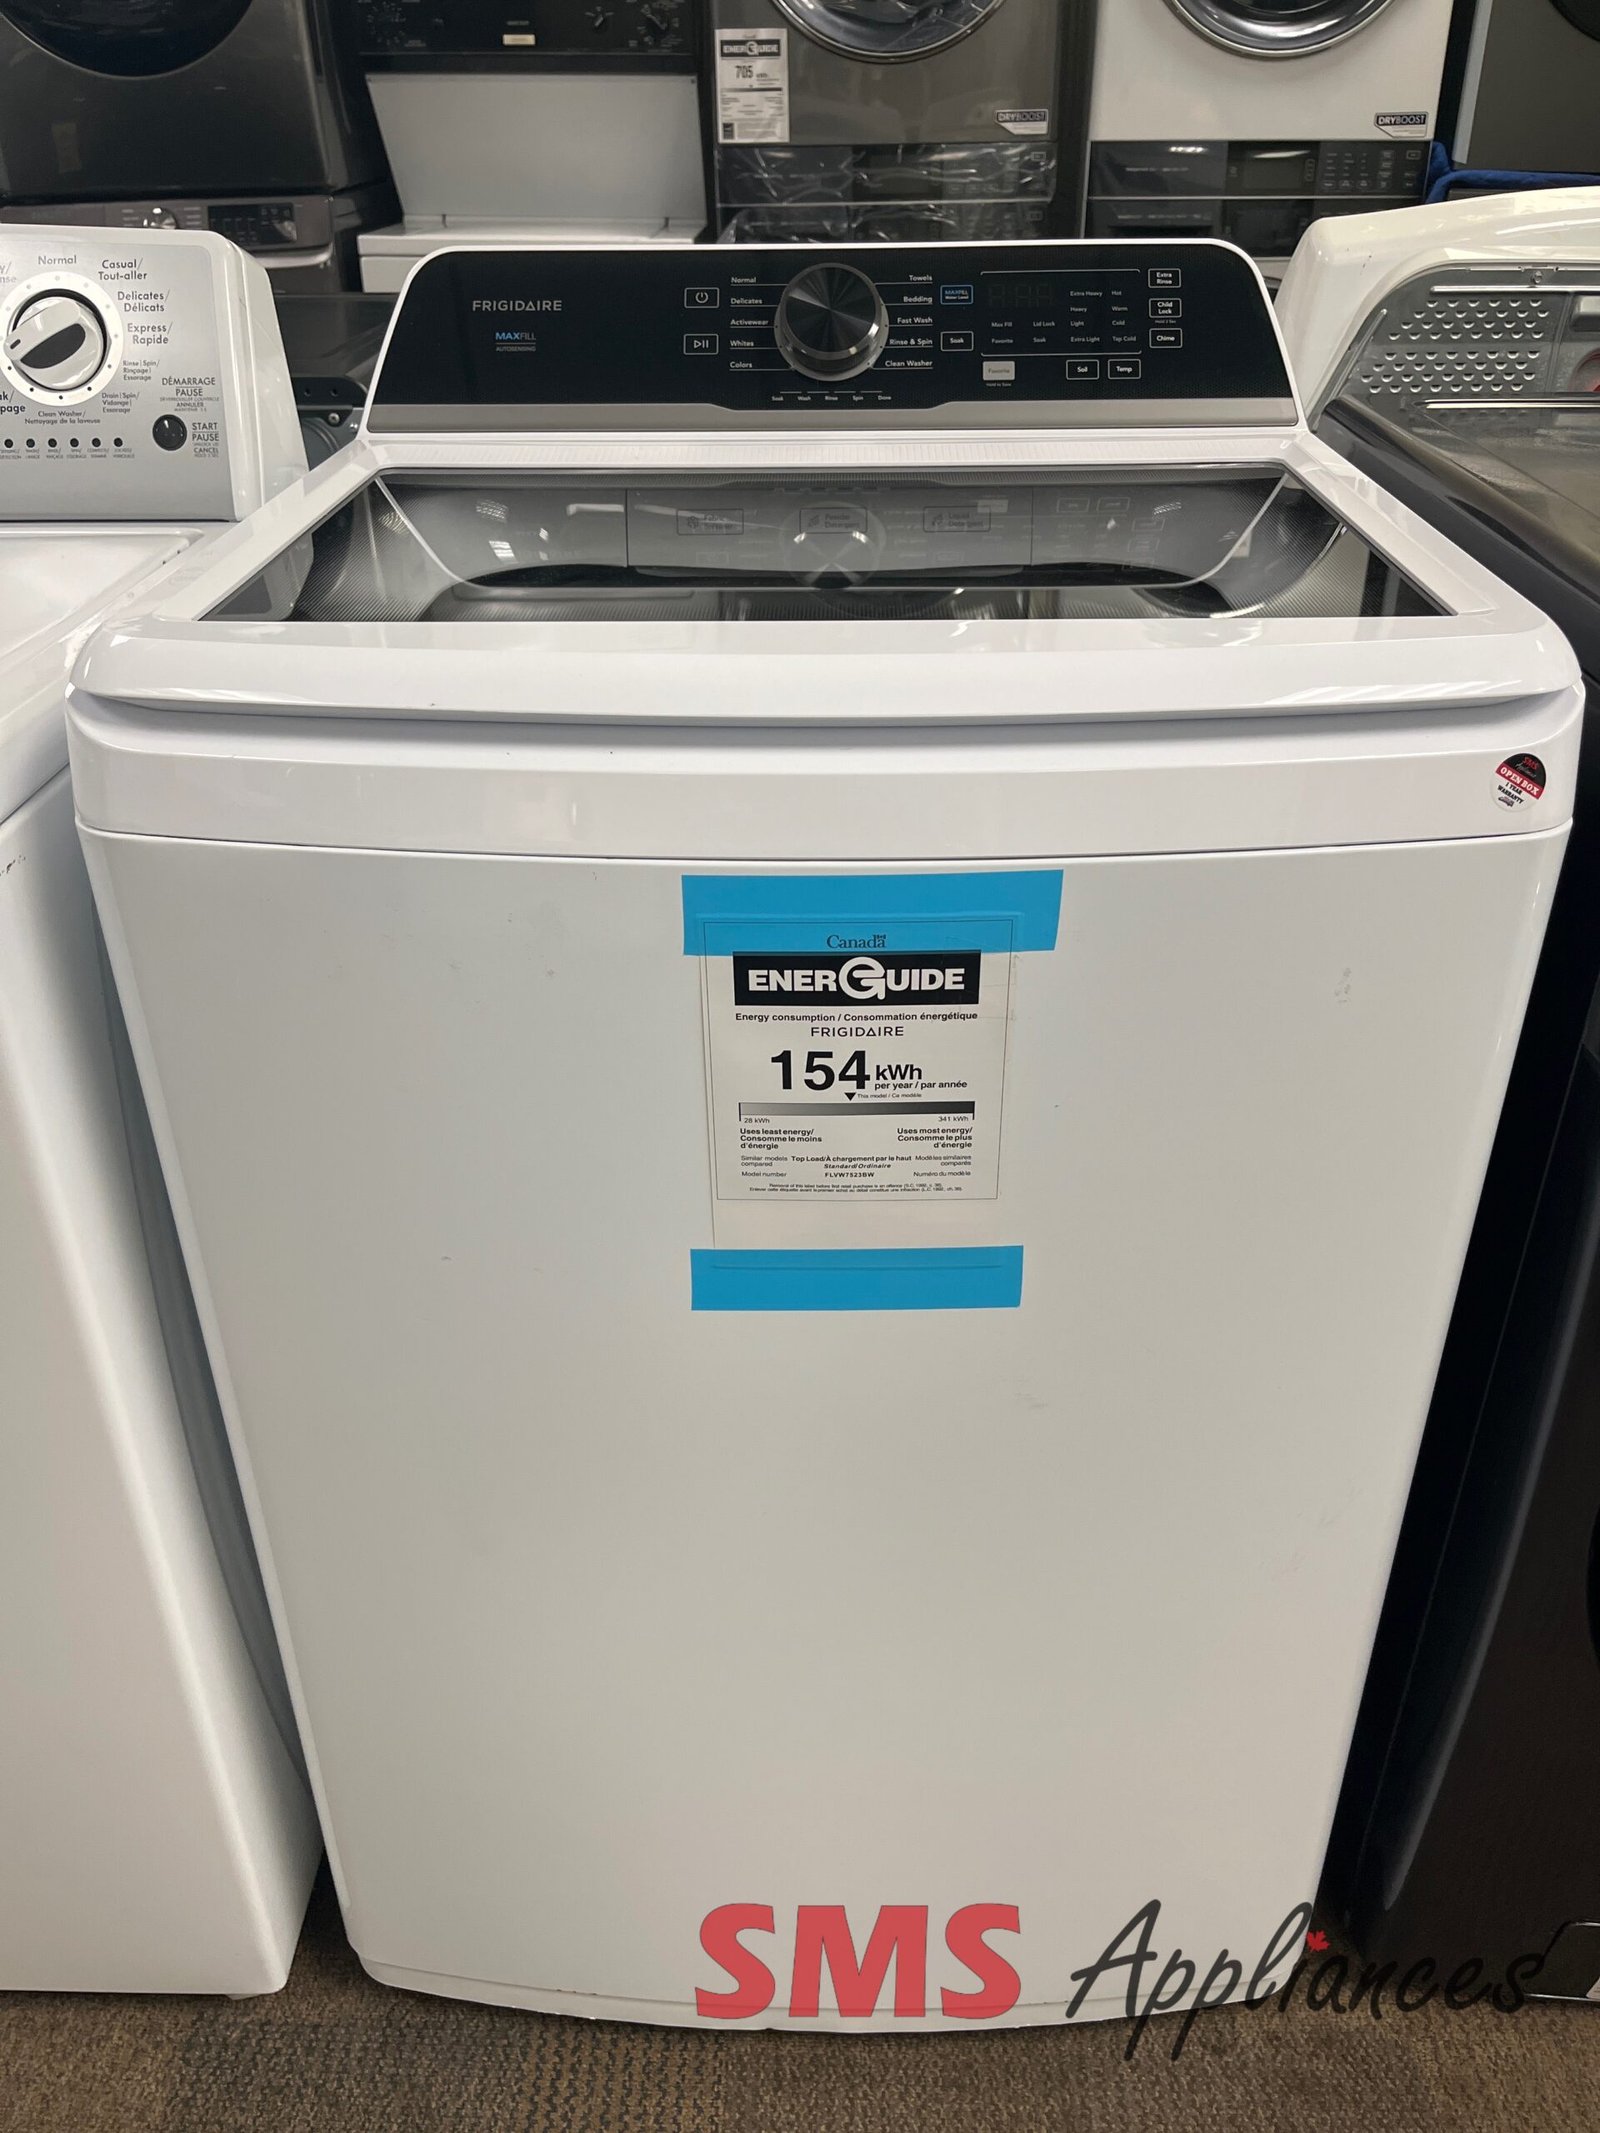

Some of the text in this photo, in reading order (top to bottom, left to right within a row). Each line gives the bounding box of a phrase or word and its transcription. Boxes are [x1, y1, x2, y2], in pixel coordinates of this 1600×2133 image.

[735, 65, 753, 79] 705
[1378, 115, 1425, 125] DRYBOOST
[38, 254, 77, 265] Normal
[102, 258, 143, 270] Casual/
[98, 271, 147, 281] Tout-aller
[118, 289, 170, 301] Delicates/
[904, 296, 933, 304] Bedding
[124, 302, 165, 312] Délicats
[472, 300, 562, 312] FRIGIDAIRE
[128, 322, 173, 335] Express/
[133, 334, 169, 346] Rapide
[496, 332, 536, 341] MAXFILL
[917, 339, 933, 347] Spin
[1116, 366, 1132, 374] Temp
[162, 377, 216, 386] DÉMARRAGE
[192, 422, 218, 430] START
[192, 434, 220, 442] PAUSE
[1500, 767, 1522, 784] OPEN
[1521, 780, 1540, 796] BOX
[1510, 783, 1523, 795] YEAR
[1498, 785, 1524, 804] WARRANTY
[827, 934, 886, 949] Canada
[748, 956, 965, 1000] ENERGUIDE
[736, 1013, 769, 1022] Energy
[772, 1014, 835, 1022] consumption
[844, 1013, 917, 1022] Consommation
[920, 1012, 978, 1021] énergétique
[811, 1026, 904, 1037] FRIGIDAIRE
[771, 1050, 922, 1091] 154 kWh
[875, 1083, 892, 1091] per
[893, 1082, 913, 1090] year
[921, 1082, 936, 1090] par
[939, 1080, 968, 1088] année
[782, 1128, 814, 1136] energy/
[941, 1127, 973, 1135] energy/
[955, 1134, 973, 1142] plus
[934, 1141, 972, 1149] d'énergie
